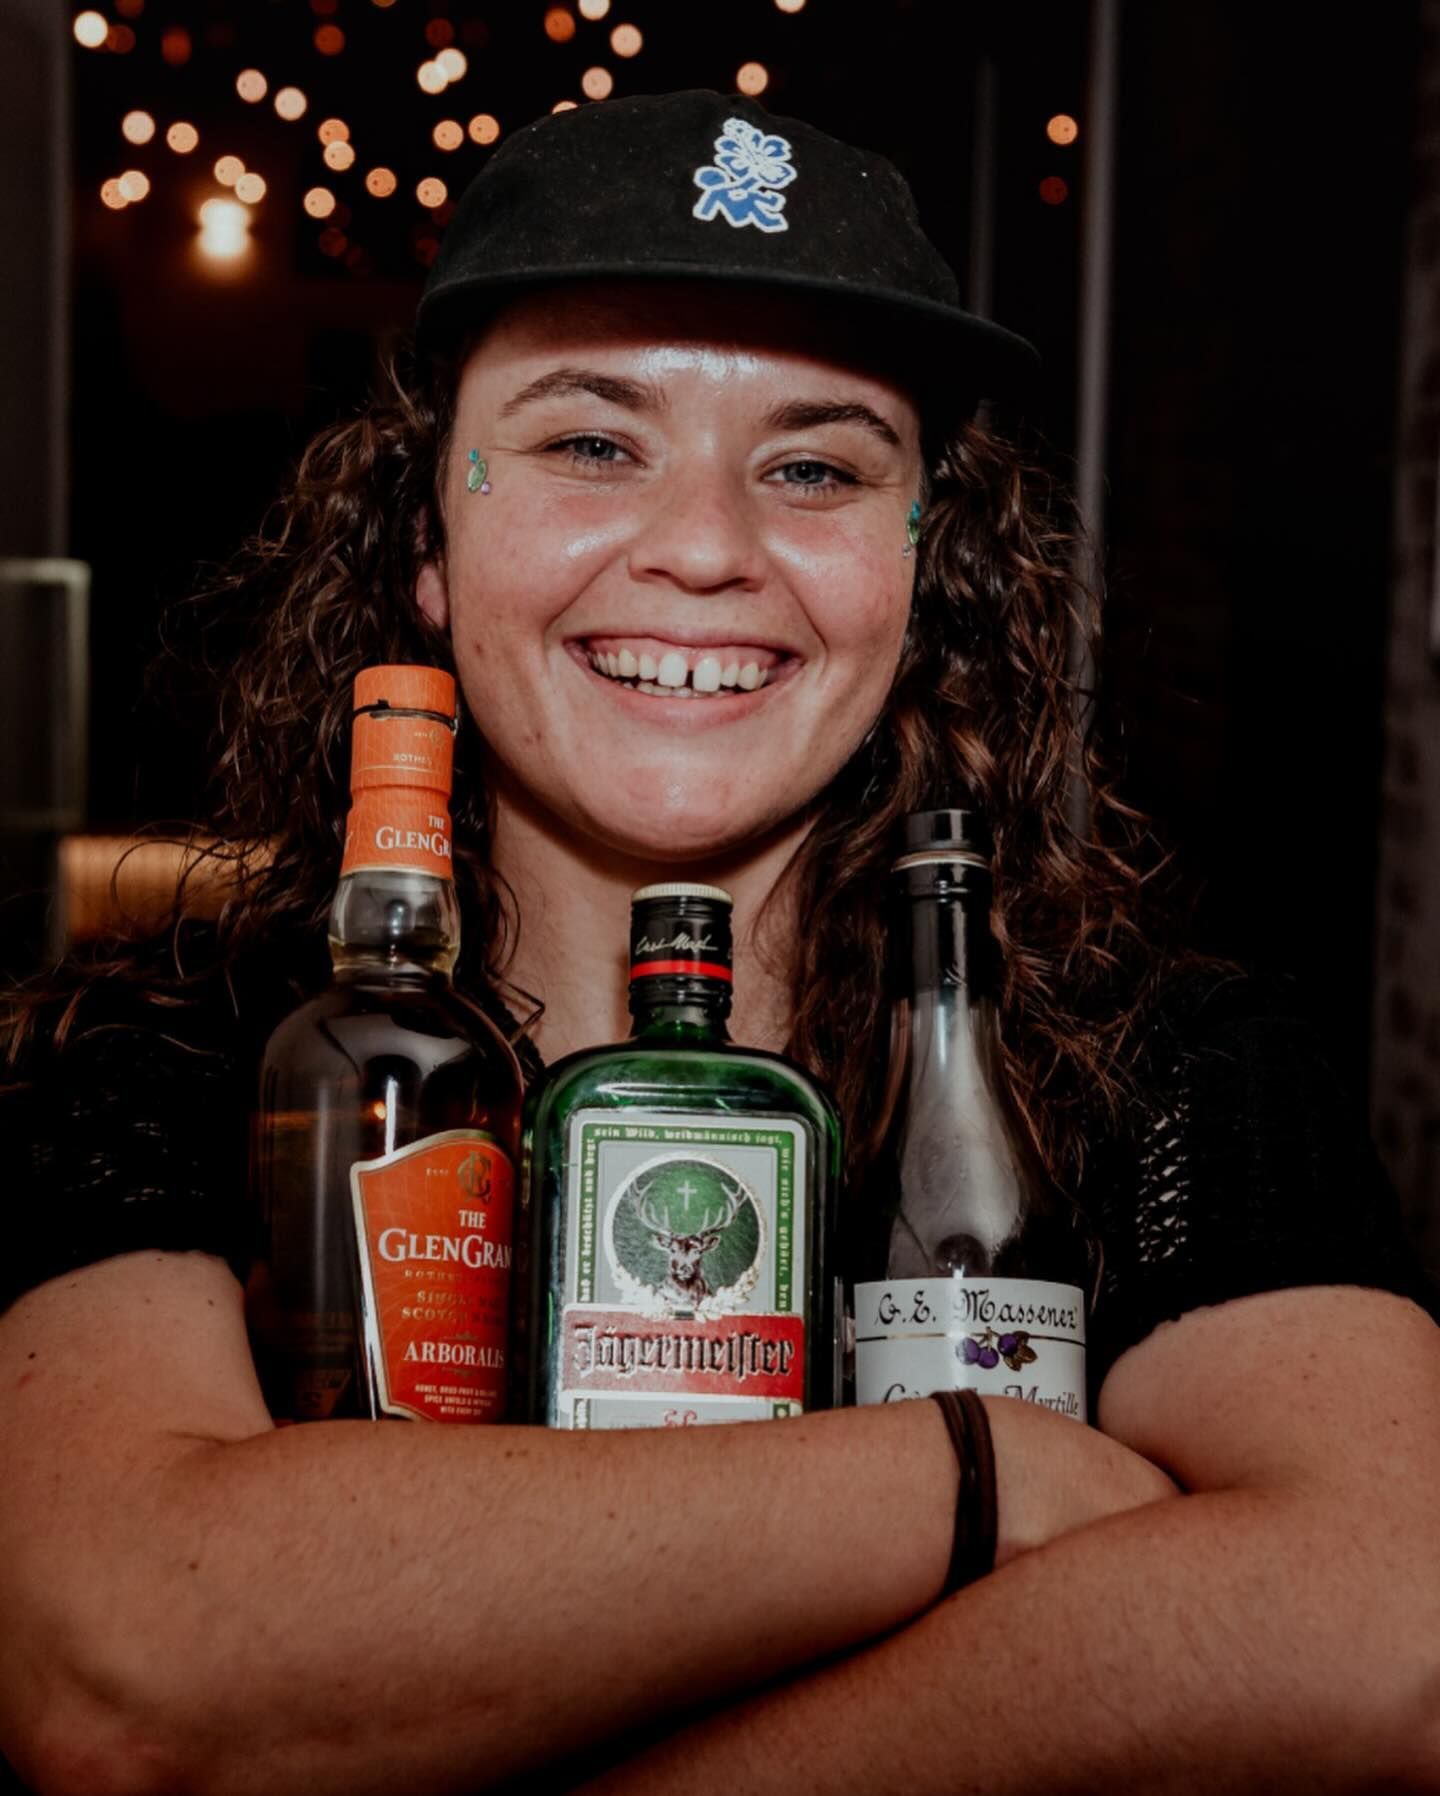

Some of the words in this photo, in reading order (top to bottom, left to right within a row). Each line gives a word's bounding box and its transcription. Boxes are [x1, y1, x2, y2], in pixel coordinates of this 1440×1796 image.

[428, 815, 445, 831] THE
[375, 825, 451, 859] GLENGR
[458, 1209, 487, 1229] THE
[378, 1228, 512, 1269] GLENGRAN
[953, 1288, 1078, 1330] Massenez
[573, 1323, 795, 1381] Jägermeister
